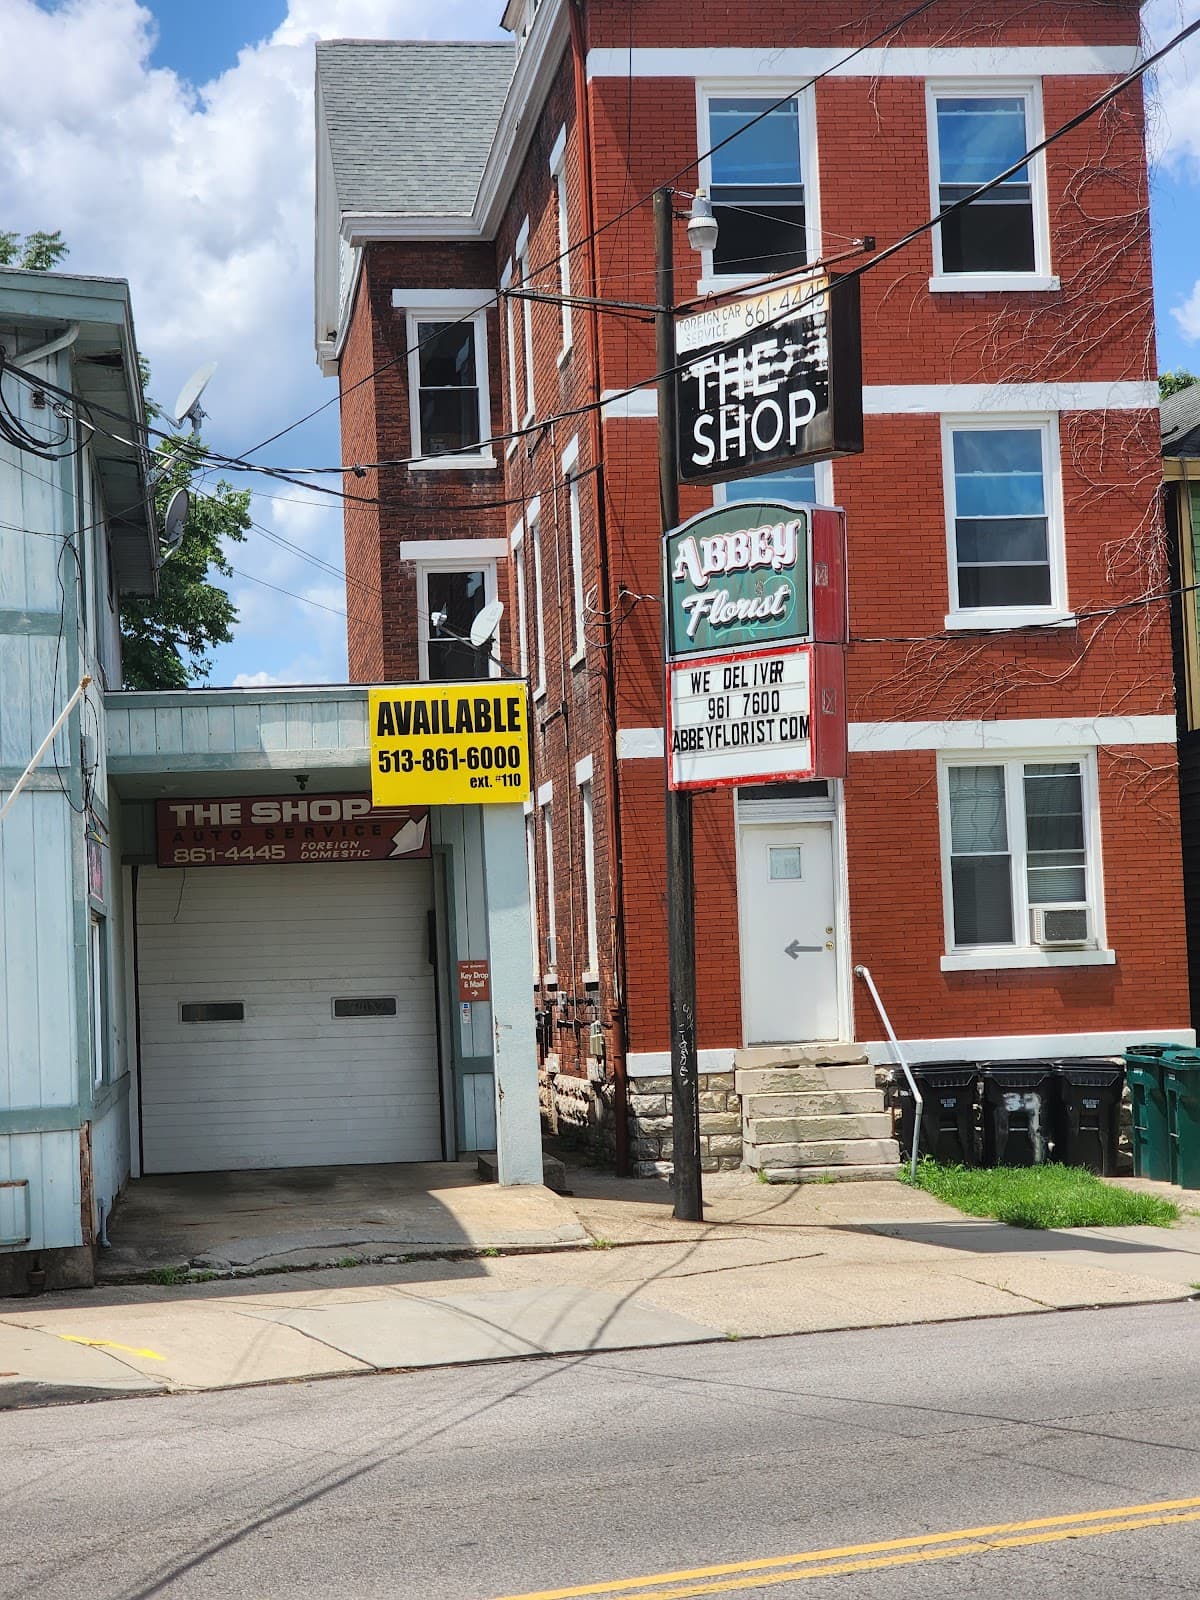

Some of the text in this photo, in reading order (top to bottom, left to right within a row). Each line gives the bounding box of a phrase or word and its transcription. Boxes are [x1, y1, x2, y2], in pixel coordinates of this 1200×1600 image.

[680, 311, 720, 331] FOREIGN
[722, 304, 741, 321] CAR
[685, 323, 729, 346] SERVICE
[688, 339, 779, 410] THE
[691, 389, 817, 465] SHOP
[672, 520, 801, 588] ABBEY
[682, 584, 792, 639] Florist
[691, 660, 784, 695] WE DELIVER
[377, 697, 521, 737] AVAILABLE
[708, 690, 780, 720] 961 7600
[378, 745, 520, 773] 513-861-6000
[470, 773, 521, 788] ext. #110
[169, 798, 371, 827] THE SHOP
[173, 824, 382, 843] AUTO SERVICE
[300, 840, 360, 850] FOREIGN
[174, 844, 286, 863] 861-4445
[300, 849, 371, 860] DOMESTIC
[460, 971, 489, 981] Key Drop
[469, 980, 485, 988] Mail
